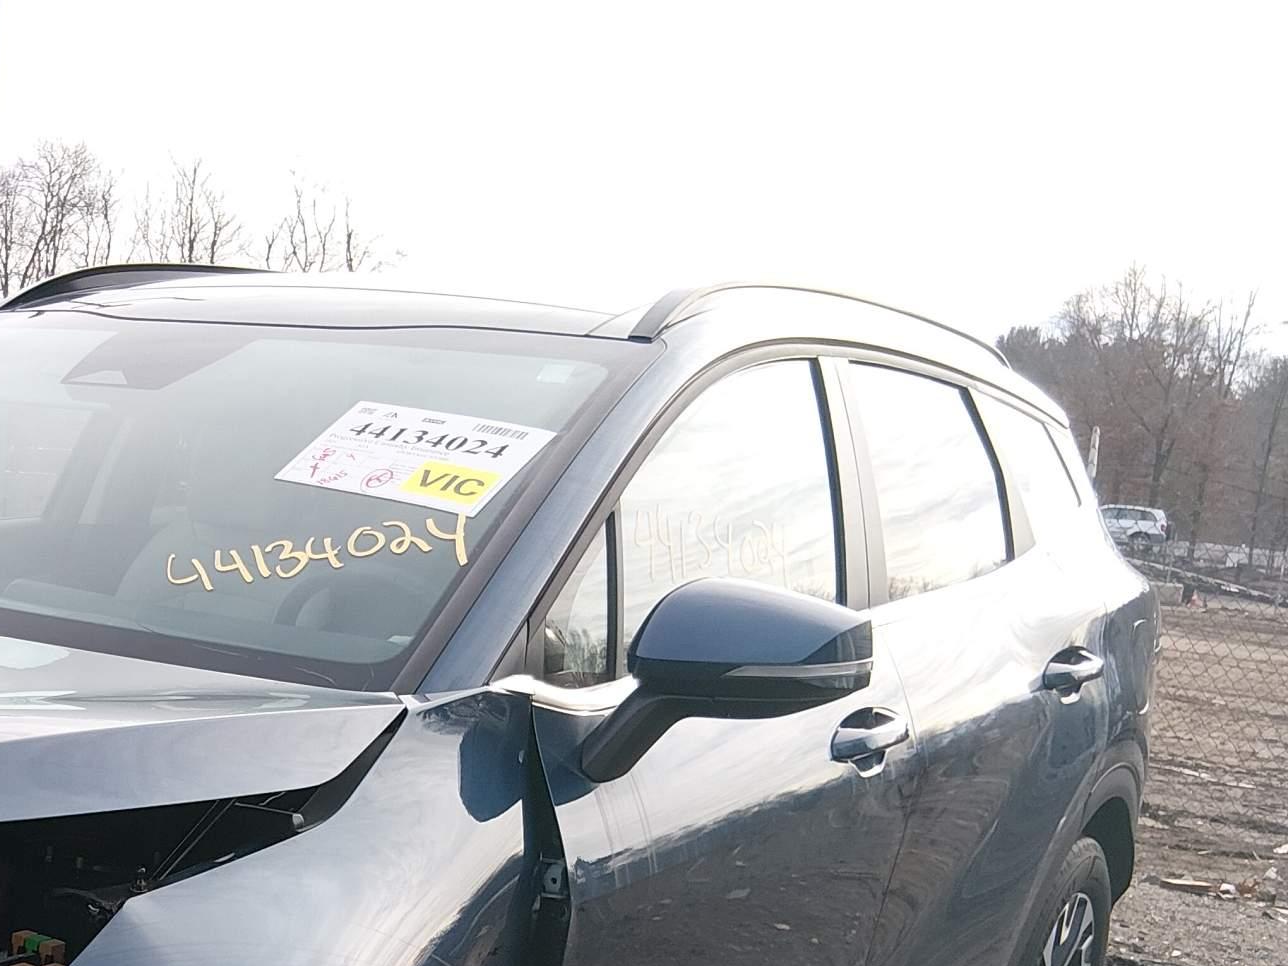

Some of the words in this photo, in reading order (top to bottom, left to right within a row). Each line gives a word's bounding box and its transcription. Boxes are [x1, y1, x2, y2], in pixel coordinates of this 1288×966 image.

[349, 422, 510, 460] 44134024
[419, 468, 485, 497] VIC
[166, 513, 470, 592] 44134024
